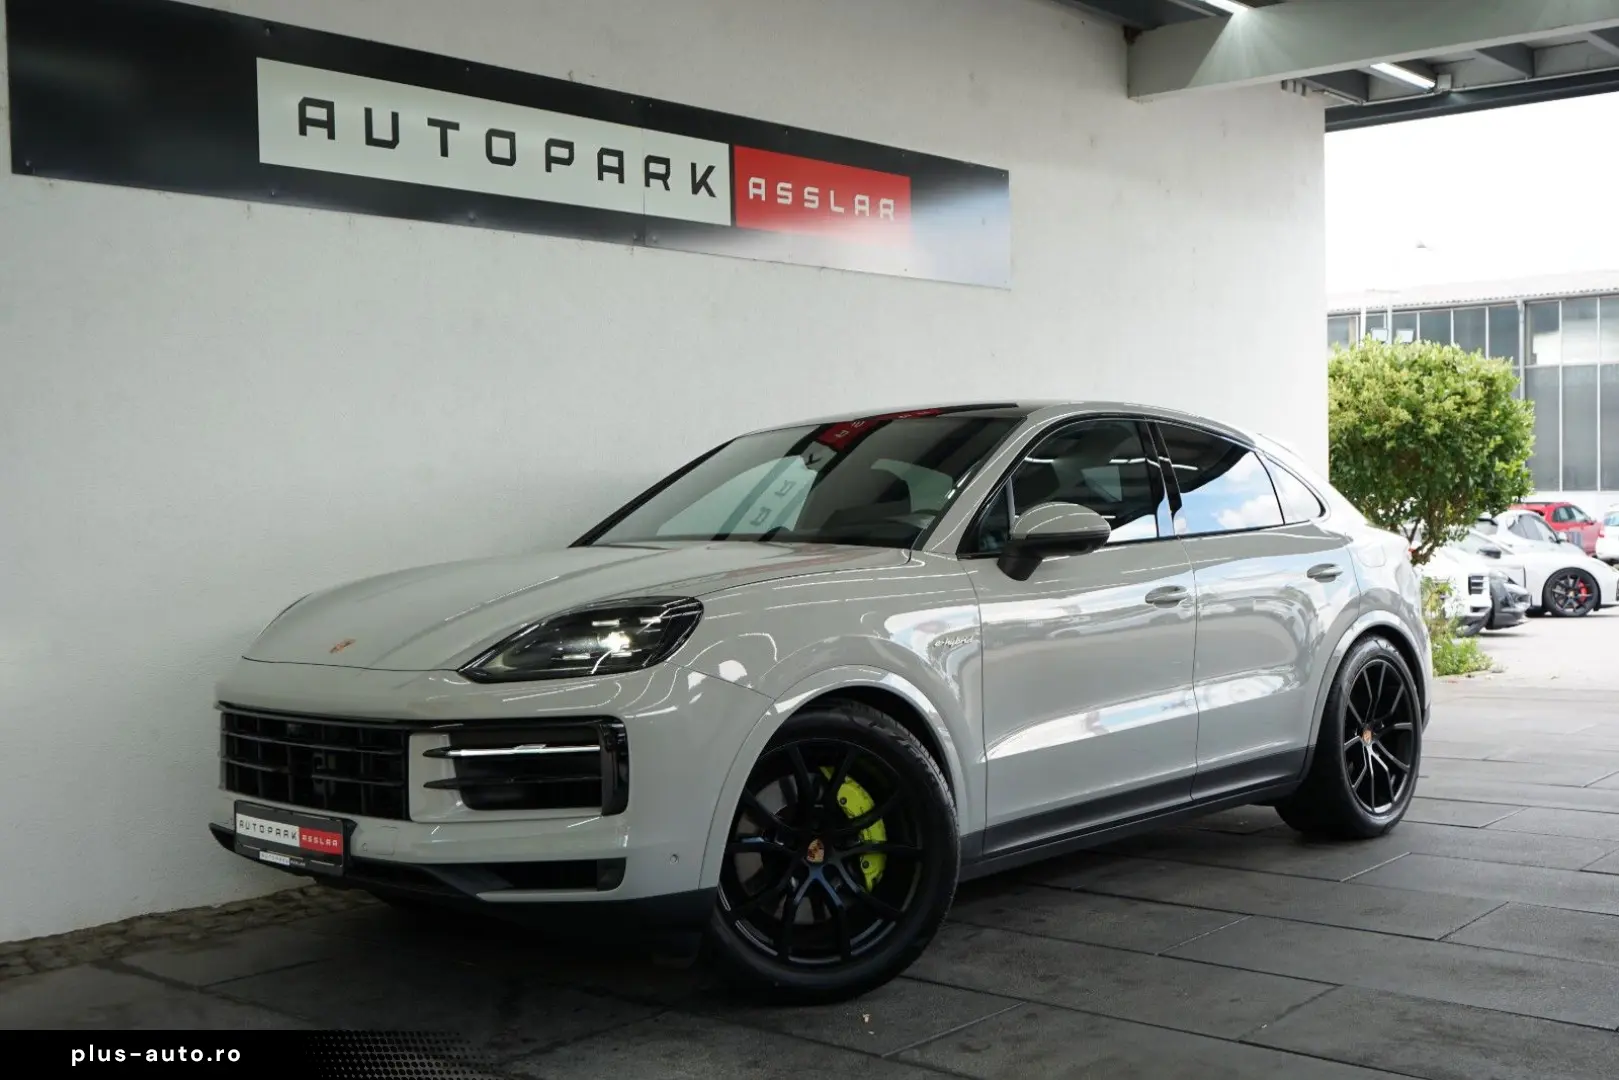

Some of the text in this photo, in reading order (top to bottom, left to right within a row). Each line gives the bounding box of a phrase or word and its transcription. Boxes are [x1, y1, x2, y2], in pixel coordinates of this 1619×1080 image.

[298, 96, 895, 222] AUTOPARK ASSLAR
[238, 819, 338, 847] AUTOPARK ASSLAR
